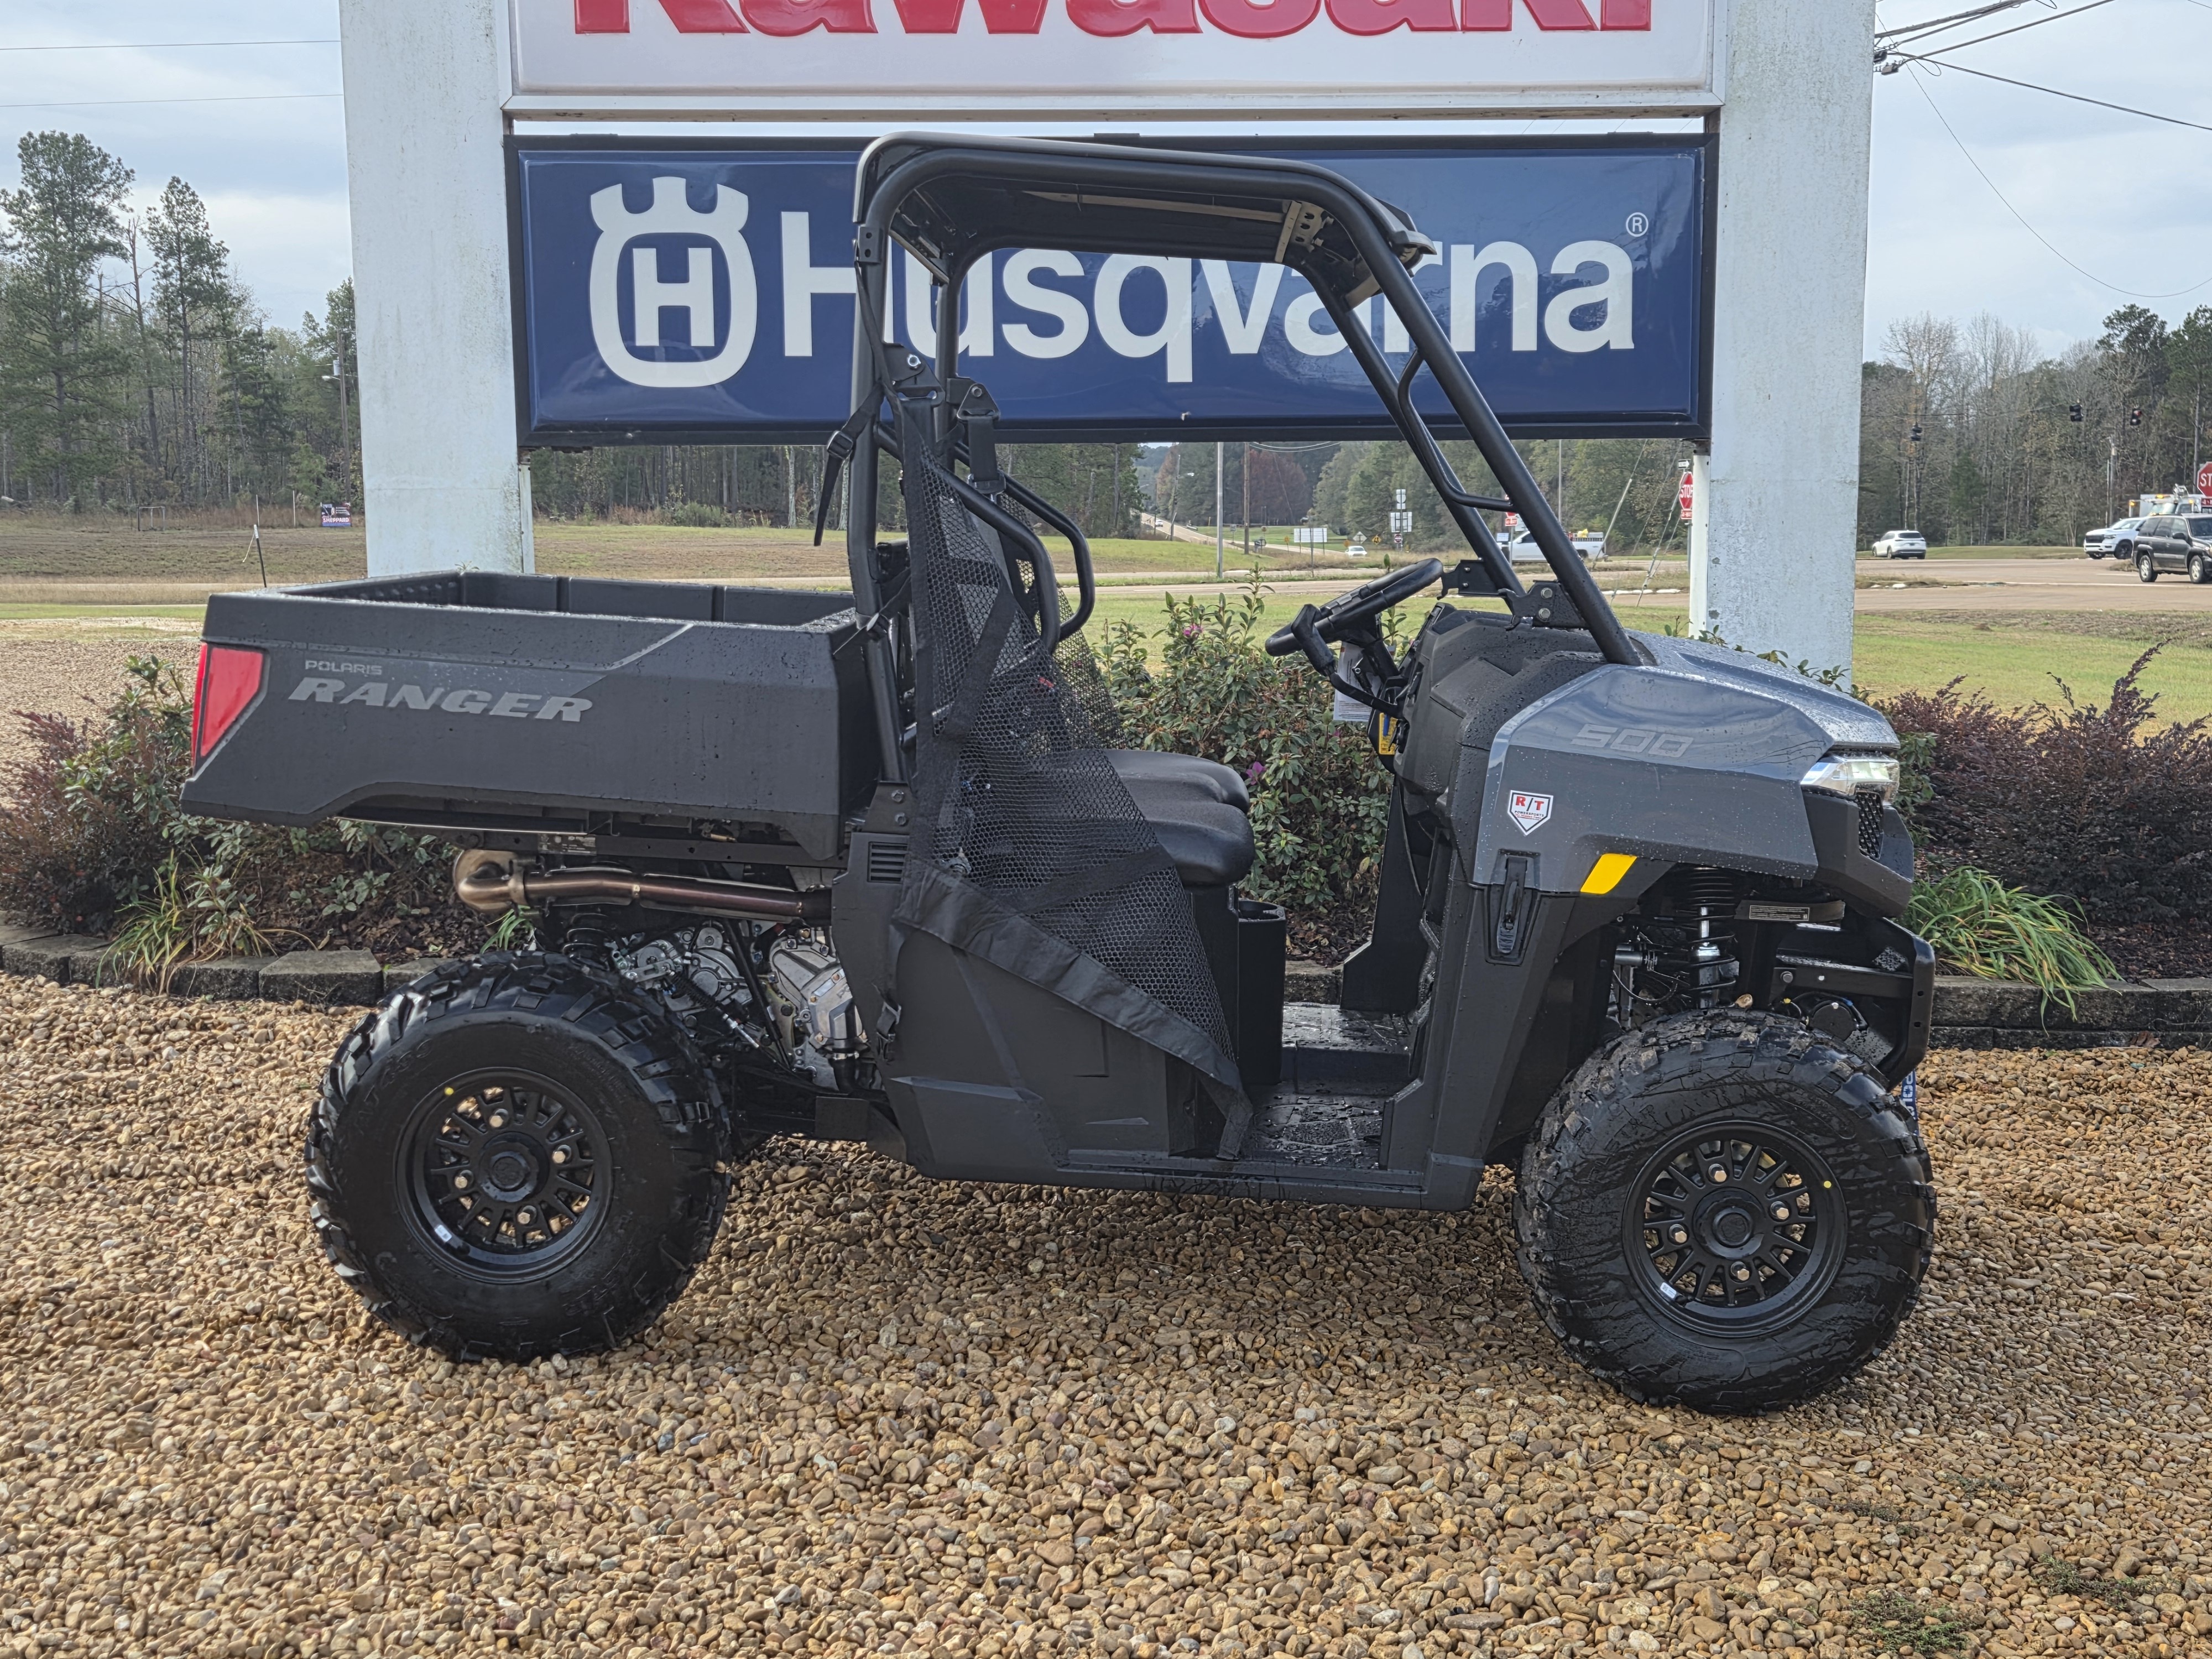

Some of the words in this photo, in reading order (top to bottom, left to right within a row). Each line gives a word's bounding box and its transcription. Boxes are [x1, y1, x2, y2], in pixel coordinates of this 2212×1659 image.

[781, 211, 1635, 383] Husqvarna
[2200, 473, 2212, 487] ST
[305, 660, 383, 675] POLARIS
[288, 677, 593, 722] RANGER
[1570, 723, 1694, 758] 500
[1515, 796, 1544, 811] R/T
